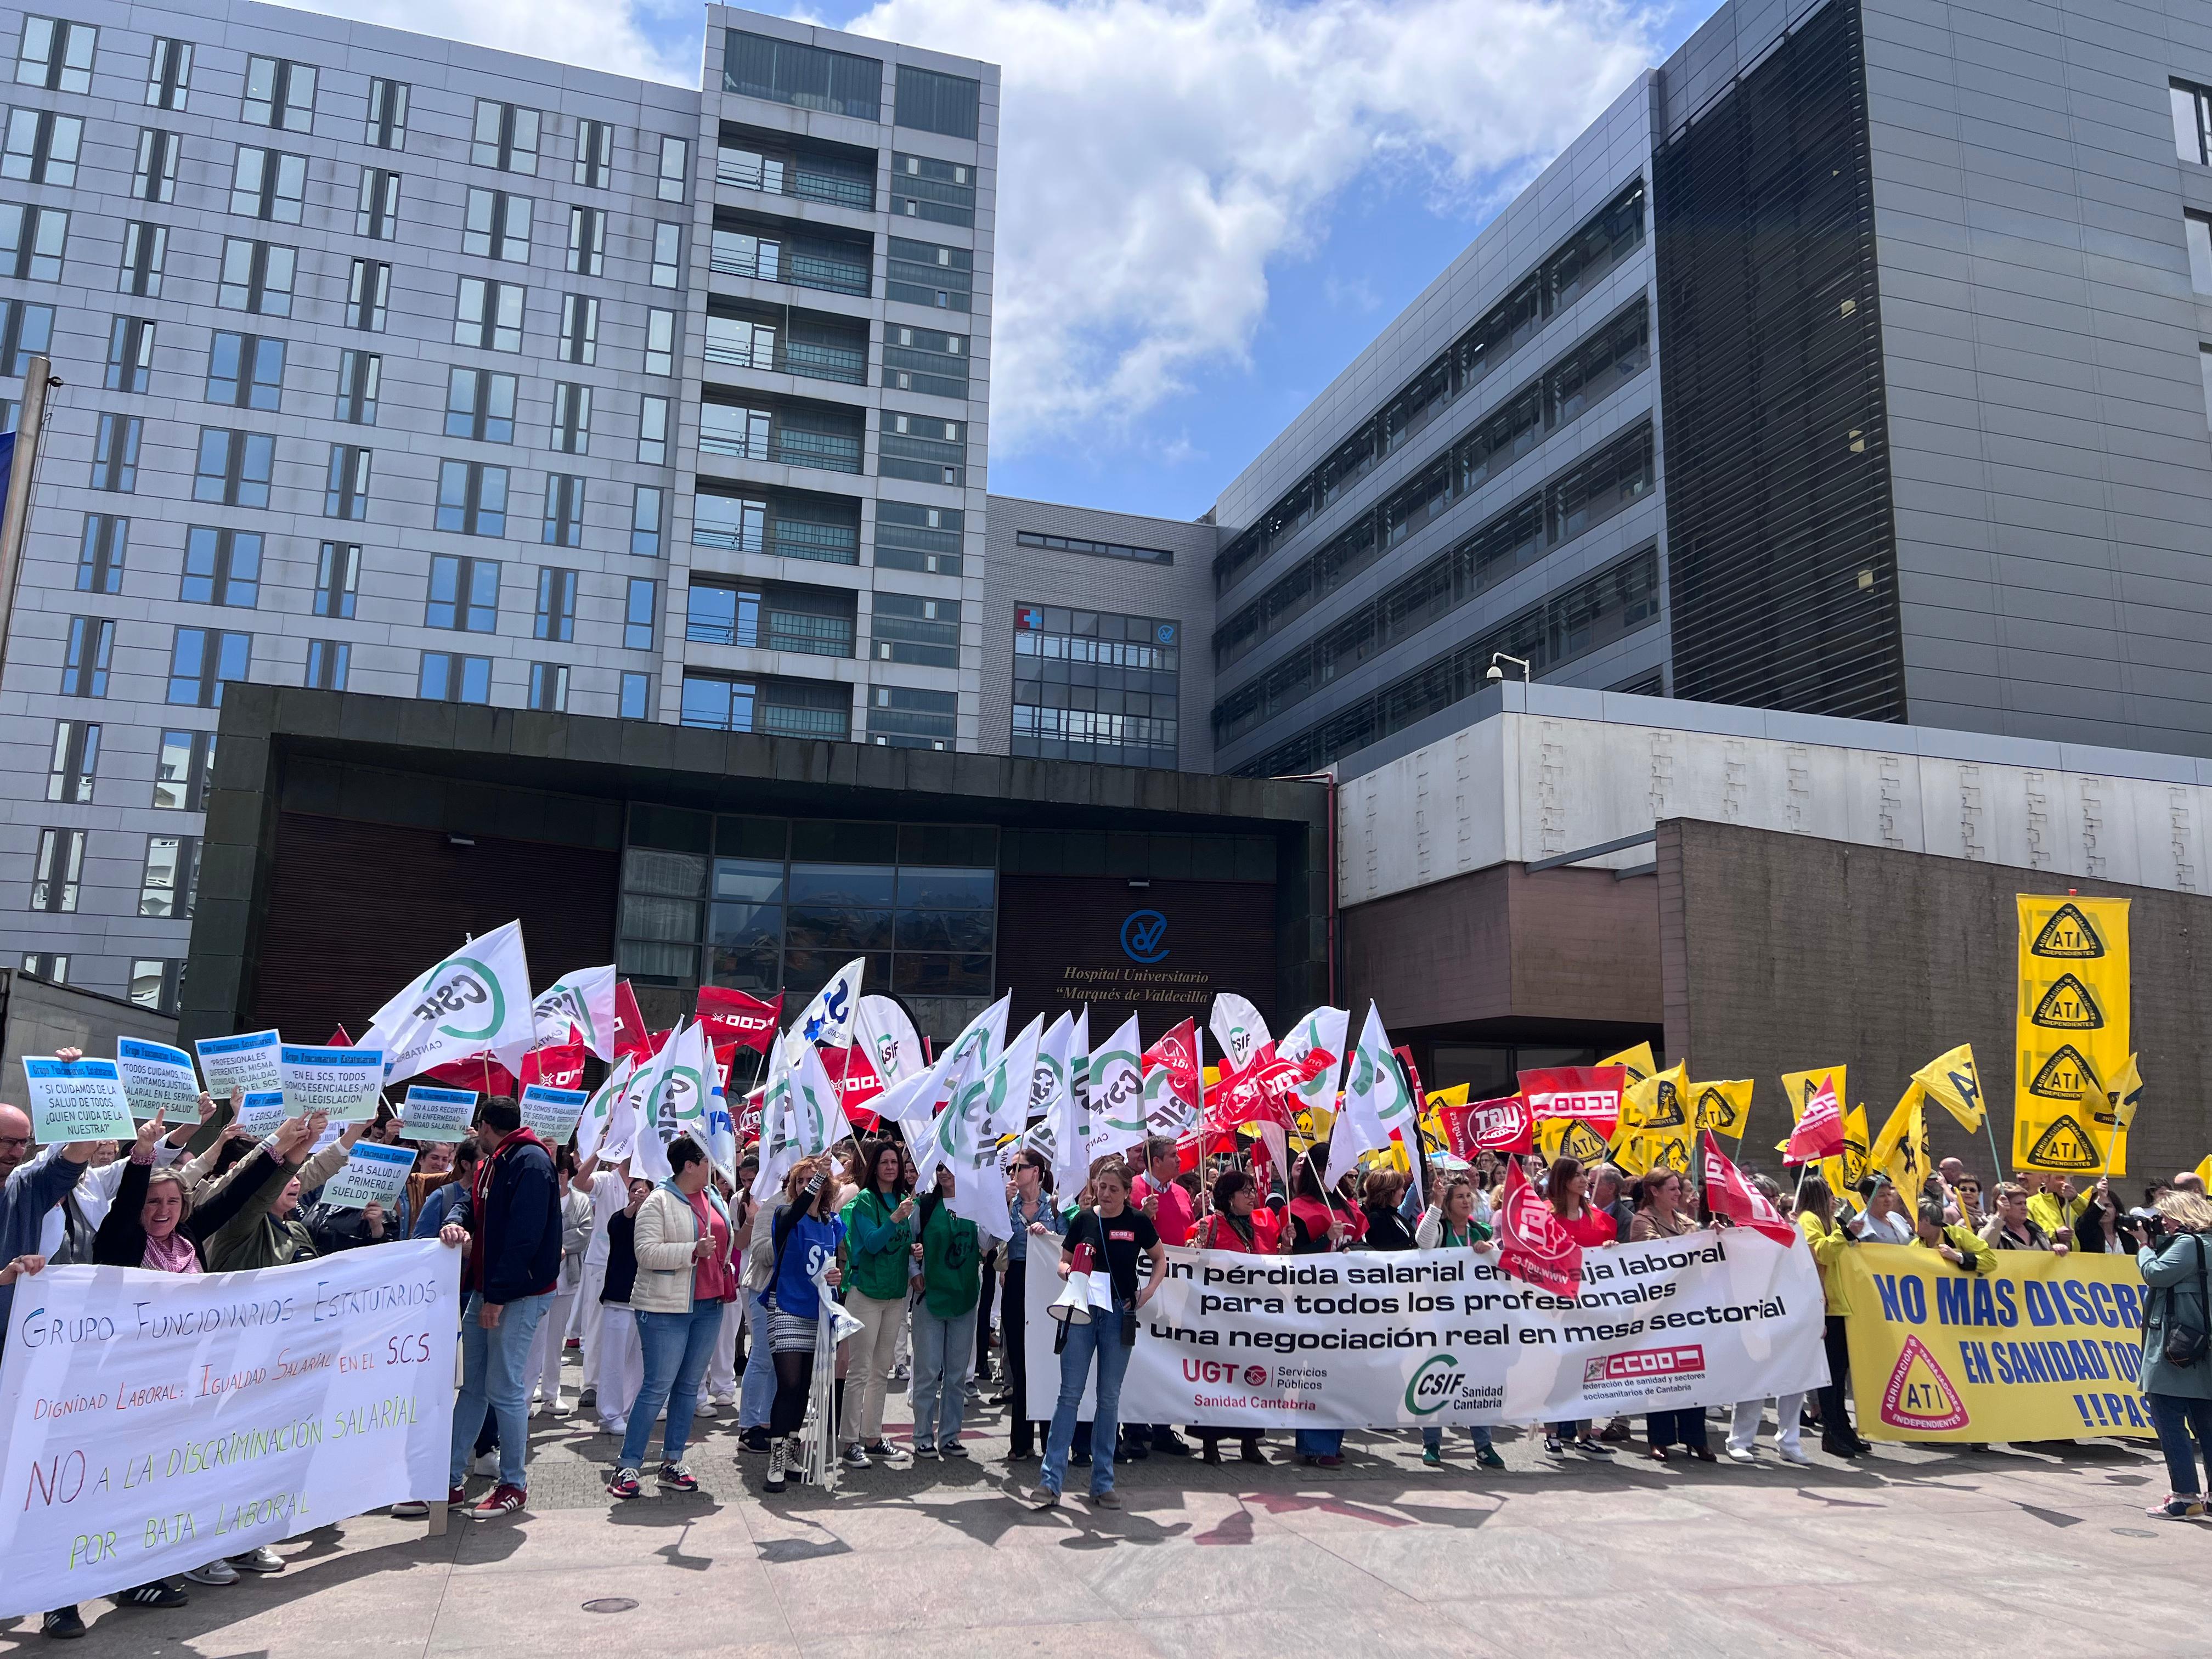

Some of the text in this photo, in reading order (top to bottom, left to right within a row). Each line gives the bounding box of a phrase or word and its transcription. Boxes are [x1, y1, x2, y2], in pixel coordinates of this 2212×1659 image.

[2053, 932, 2080, 947] ATI
[1063, 967, 1209, 984] Hospital Universitario
[1124, 989, 1140, 1001] de
[2052, 1001, 2080, 1018] ATI
[123, 1063, 180, 1079] "TODOS CUIDAMOS,
[248, 1061, 274, 1073] MISMA
[239, 1069, 277, 1084] IGUALDAD
[292, 1070, 366, 1082] "EN EL SCS, TODOS
[2051, 1072, 2079, 1090] ATI
[46, 1084, 117, 1095] SI CUIDAMOS DE LA
[285, 1081, 306, 1091] SOMOS
[308, 1083, 359, 1092] ESENCIALES
[49, 1098, 77, 1108] SALUD
[79, 1098, 89, 1107] DE
[154, 1090, 163, 1099] EN
[164, 1092, 171, 1100] EL
[174, 1093, 200, 1103] SERVICIO
[300, 1094, 307, 1102] LA
[309, 1094, 362, 1104] LEGISLACION
[127, 1098, 160, 1110] CANTABRO
[171, 1104, 194, 1113] SALUD"
[439, 1106, 468, 1115] RECORTES
[46, 1111, 123, 1125] ¿QUIEN CUIDA DE LA
[249, 1109, 282, 1121] "LEGISLAR
[67, 1124, 110, 1135] NUESTRA?"
[258, 1121, 279, 1131] POCOS
[404, 1120, 429, 1128] DIGNIDAD
[431, 1122, 457, 1131] SALARIAL
[1572, 1137, 1596, 1156] ATI
[2050, 1142, 2078, 1159] ATI
[2036, 1158, 2091, 1166] INDEPENDIENTES
[349, 1163, 401, 1178] "LA SALUD LO
[331, 1186, 368, 1200] SUELDO
[387, 1181, 394, 1190] EL
[1203, 1263, 1339, 1286] pérdida
[1348, 1261, 1465, 1284] salarial
[1474, 1265, 1511, 1282] en
[1549, 1261, 1615, 1285] baja
[1618, 1241, 1727, 1277] laboral
[1200, 1282, 1677, 1316] para todos los profesionales
[1873, 1274, 1927, 1324] NO
[22, 1280, 437, 1348] GRUPO FUNCIONARIOS ESTATUTARIOS
[1150, 1296, 1786, 1353] una negociación real en mesa sectorial
[1610, 1352, 1675, 1374] CCOO
[1959, 1341, 1995, 1384] EN
[1991, 1339, 2110, 1385] SANIDAD
[33, 1333, 431, 1420] DIGNIDAD LABORAL: IGUALDAD SALARIAL EN EL S.C.S.
[1182, 1358, 1327, 1384] UGT Servicios
[1277, 1379, 1322, 1390] Públicos
[1418, 1373, 1465, 1396] CSIF
[1583, 1373, 1706, 1390] federación de sanidad y sectores
[1920, 1348, 1961, 1413] TRABAJADORES
[1462, 1386, 1503, 1398] Sanidad
[1583, 1389, 1643, 1401] sociosanitarios
[1656, 1384, 1692, 1394] Cantabria
[1907, 1384, 1944, 1409] ATI
[1194, 1394, 1317, 1411] Sanidad Cantabria
[1453, 1397, 1502, 1410] Cantabria
[1893, 1413, 1961, 1429] INDEPENDIENTES
[24, 1395, 418, 1512] NO A LA DISCRIMINACIÓN SALARIAL
[69, 1491, 310, 1571] POR BAJA LABORAL
